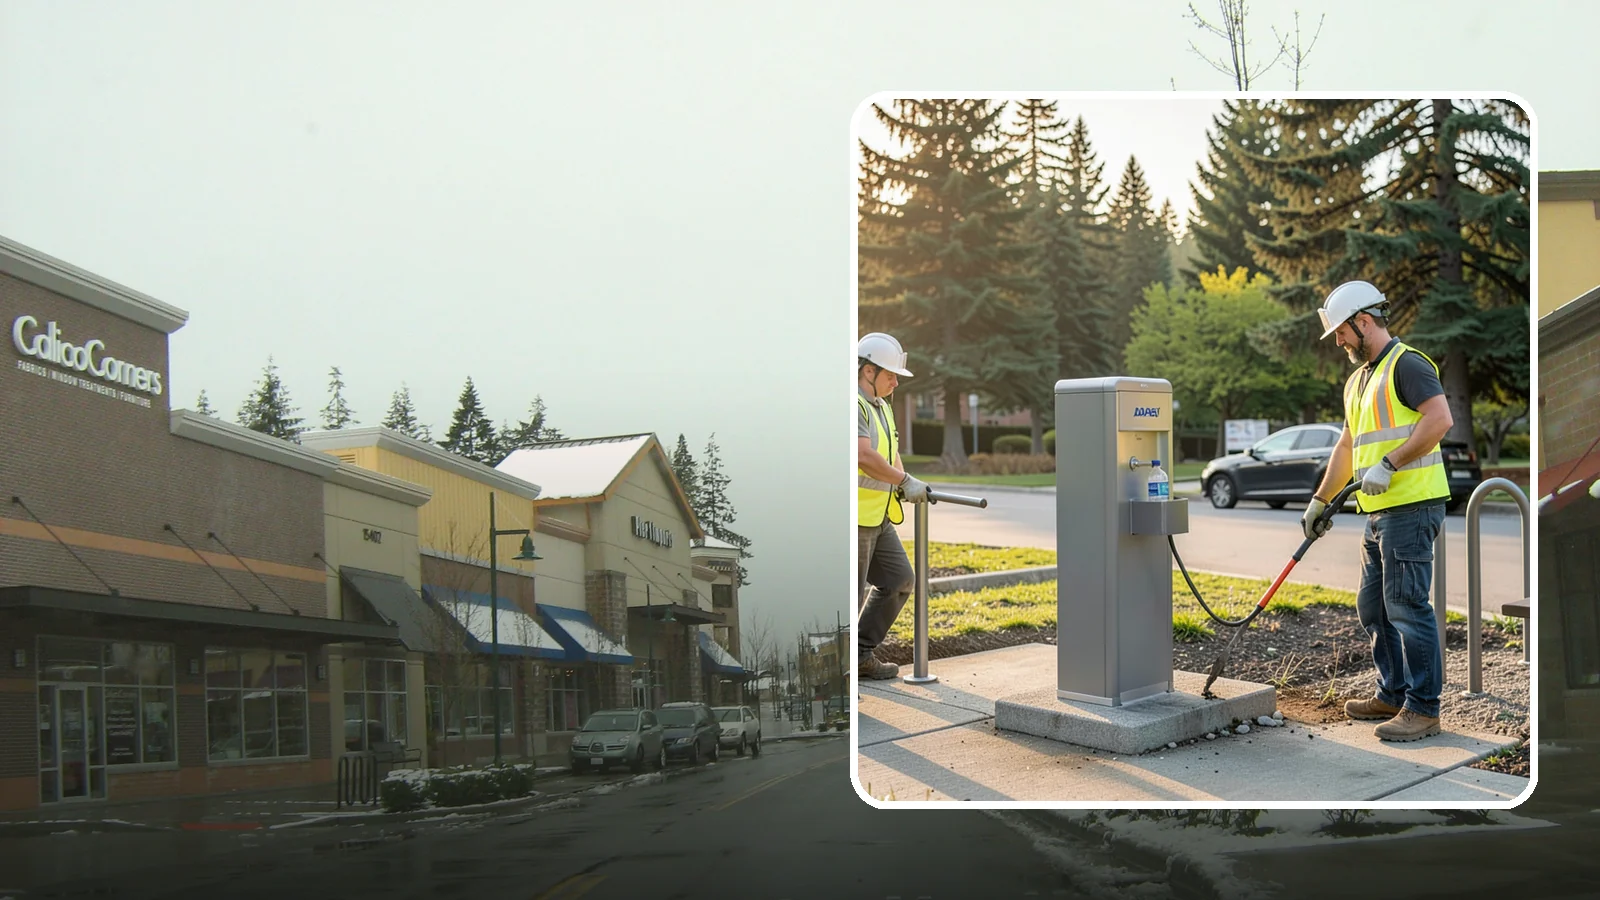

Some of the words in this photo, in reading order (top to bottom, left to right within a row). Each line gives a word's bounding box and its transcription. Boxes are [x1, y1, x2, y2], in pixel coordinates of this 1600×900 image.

[17, 360, 47, 378] FABRICS
[51, 370, 78, 386] WINDOW
[78, 378, 117, 398] TREATMENTS
[120, 391, 151, 408] FURNITURE
